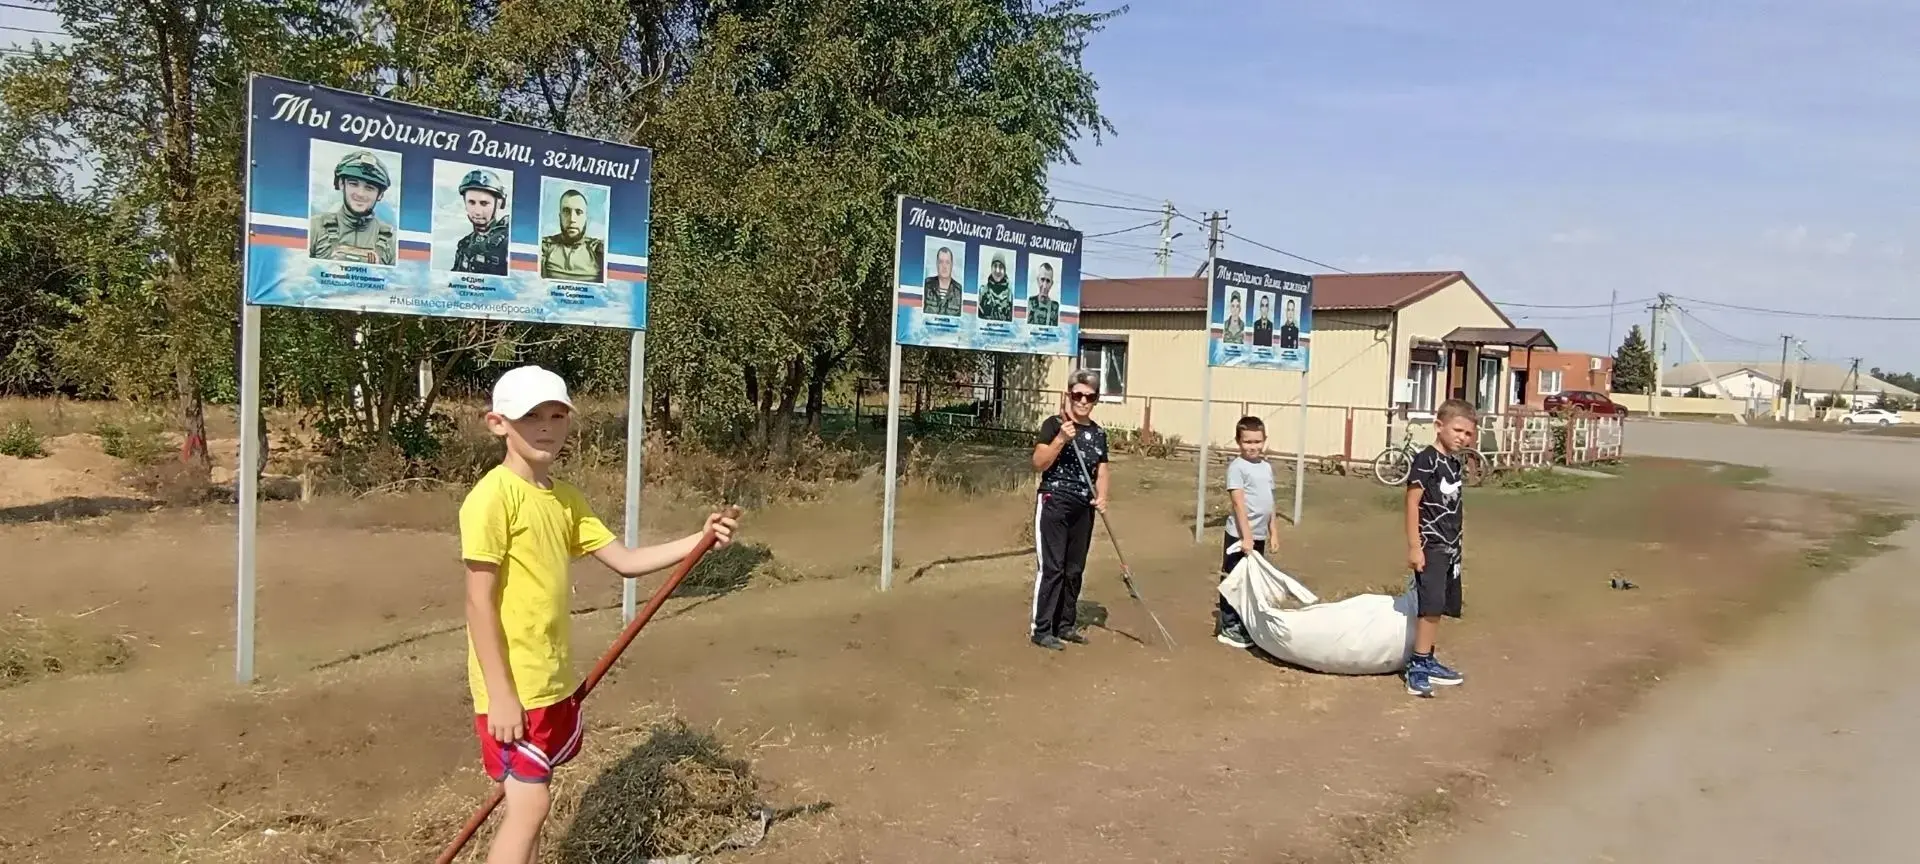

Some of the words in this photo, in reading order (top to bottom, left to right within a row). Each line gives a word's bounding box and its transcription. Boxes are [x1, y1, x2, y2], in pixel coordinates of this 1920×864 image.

[269, 93, 331, 130] Мы
[339, 113, 460, 152] гордимся
[467, 129, 536, 167] Вами,
[542, 149, 640, 181] земляки!
[909, 207, 936, 230] Мы
[938, 217, 993, 241] гордимся
[995, 224, 1027, 249] Вами,
[1029, 234, 1078, 255] земляки!
[320, 271, 350, 279] Евгений
[340, 265, 367, 273] ТЮРИН
[1216, 265, 1231, 281] Мы
